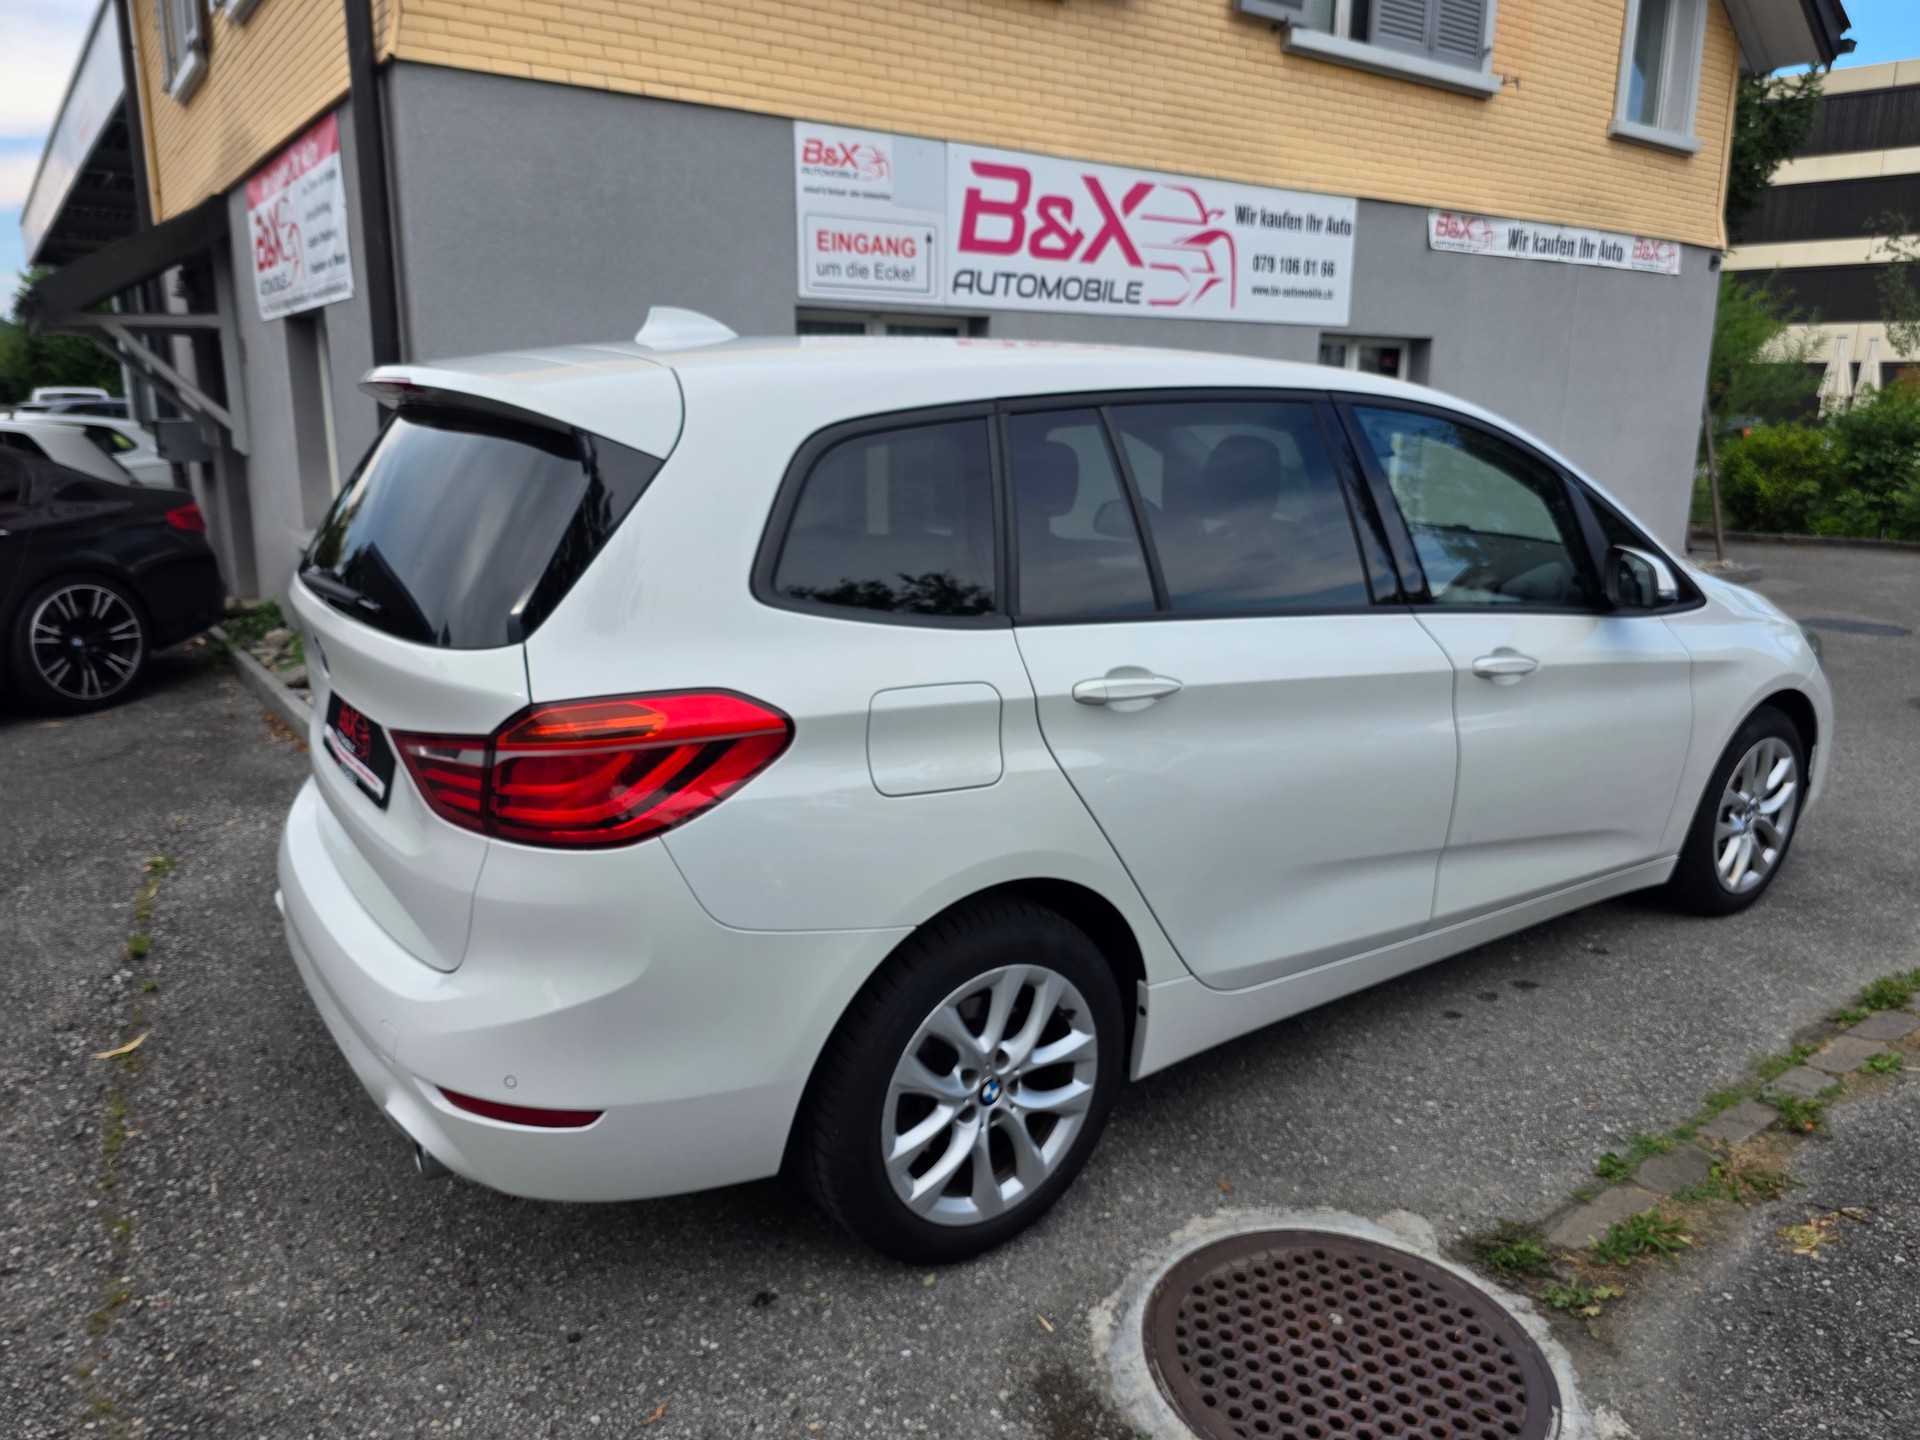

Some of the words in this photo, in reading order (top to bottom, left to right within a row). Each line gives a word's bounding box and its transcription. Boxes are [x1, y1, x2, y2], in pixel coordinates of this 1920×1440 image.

[802, 138, 860, 169] B&X
[957, 159, 1155, 268] B&X
[1234, 203, 1257, 226] Wir
[1260, 208, 1302, 231] kaufen
[1306, 213, 1323, 233] Ihr
[1325, 216, 1352, 237] Auto
[816, 229, 917, 259] EINGANG
[1507, 228, 1530, 251] Wir
[1532, 231, 1576, 257] kaufen
[1579, 237, 1596, 259] Ihr
[1598, 239, 1623, 263] Auto
[816, 262, 842, 278] um
[845, 261, 870, 279] die
[874, 262, 917, 283] Ecke!
[1252, 253, 1275, 273] 079
[1279, 256, 1300, 275] 106
[1303, 259, 1316, 277] 01
[952, 269, 1144, 306] AUTOMOBILE
